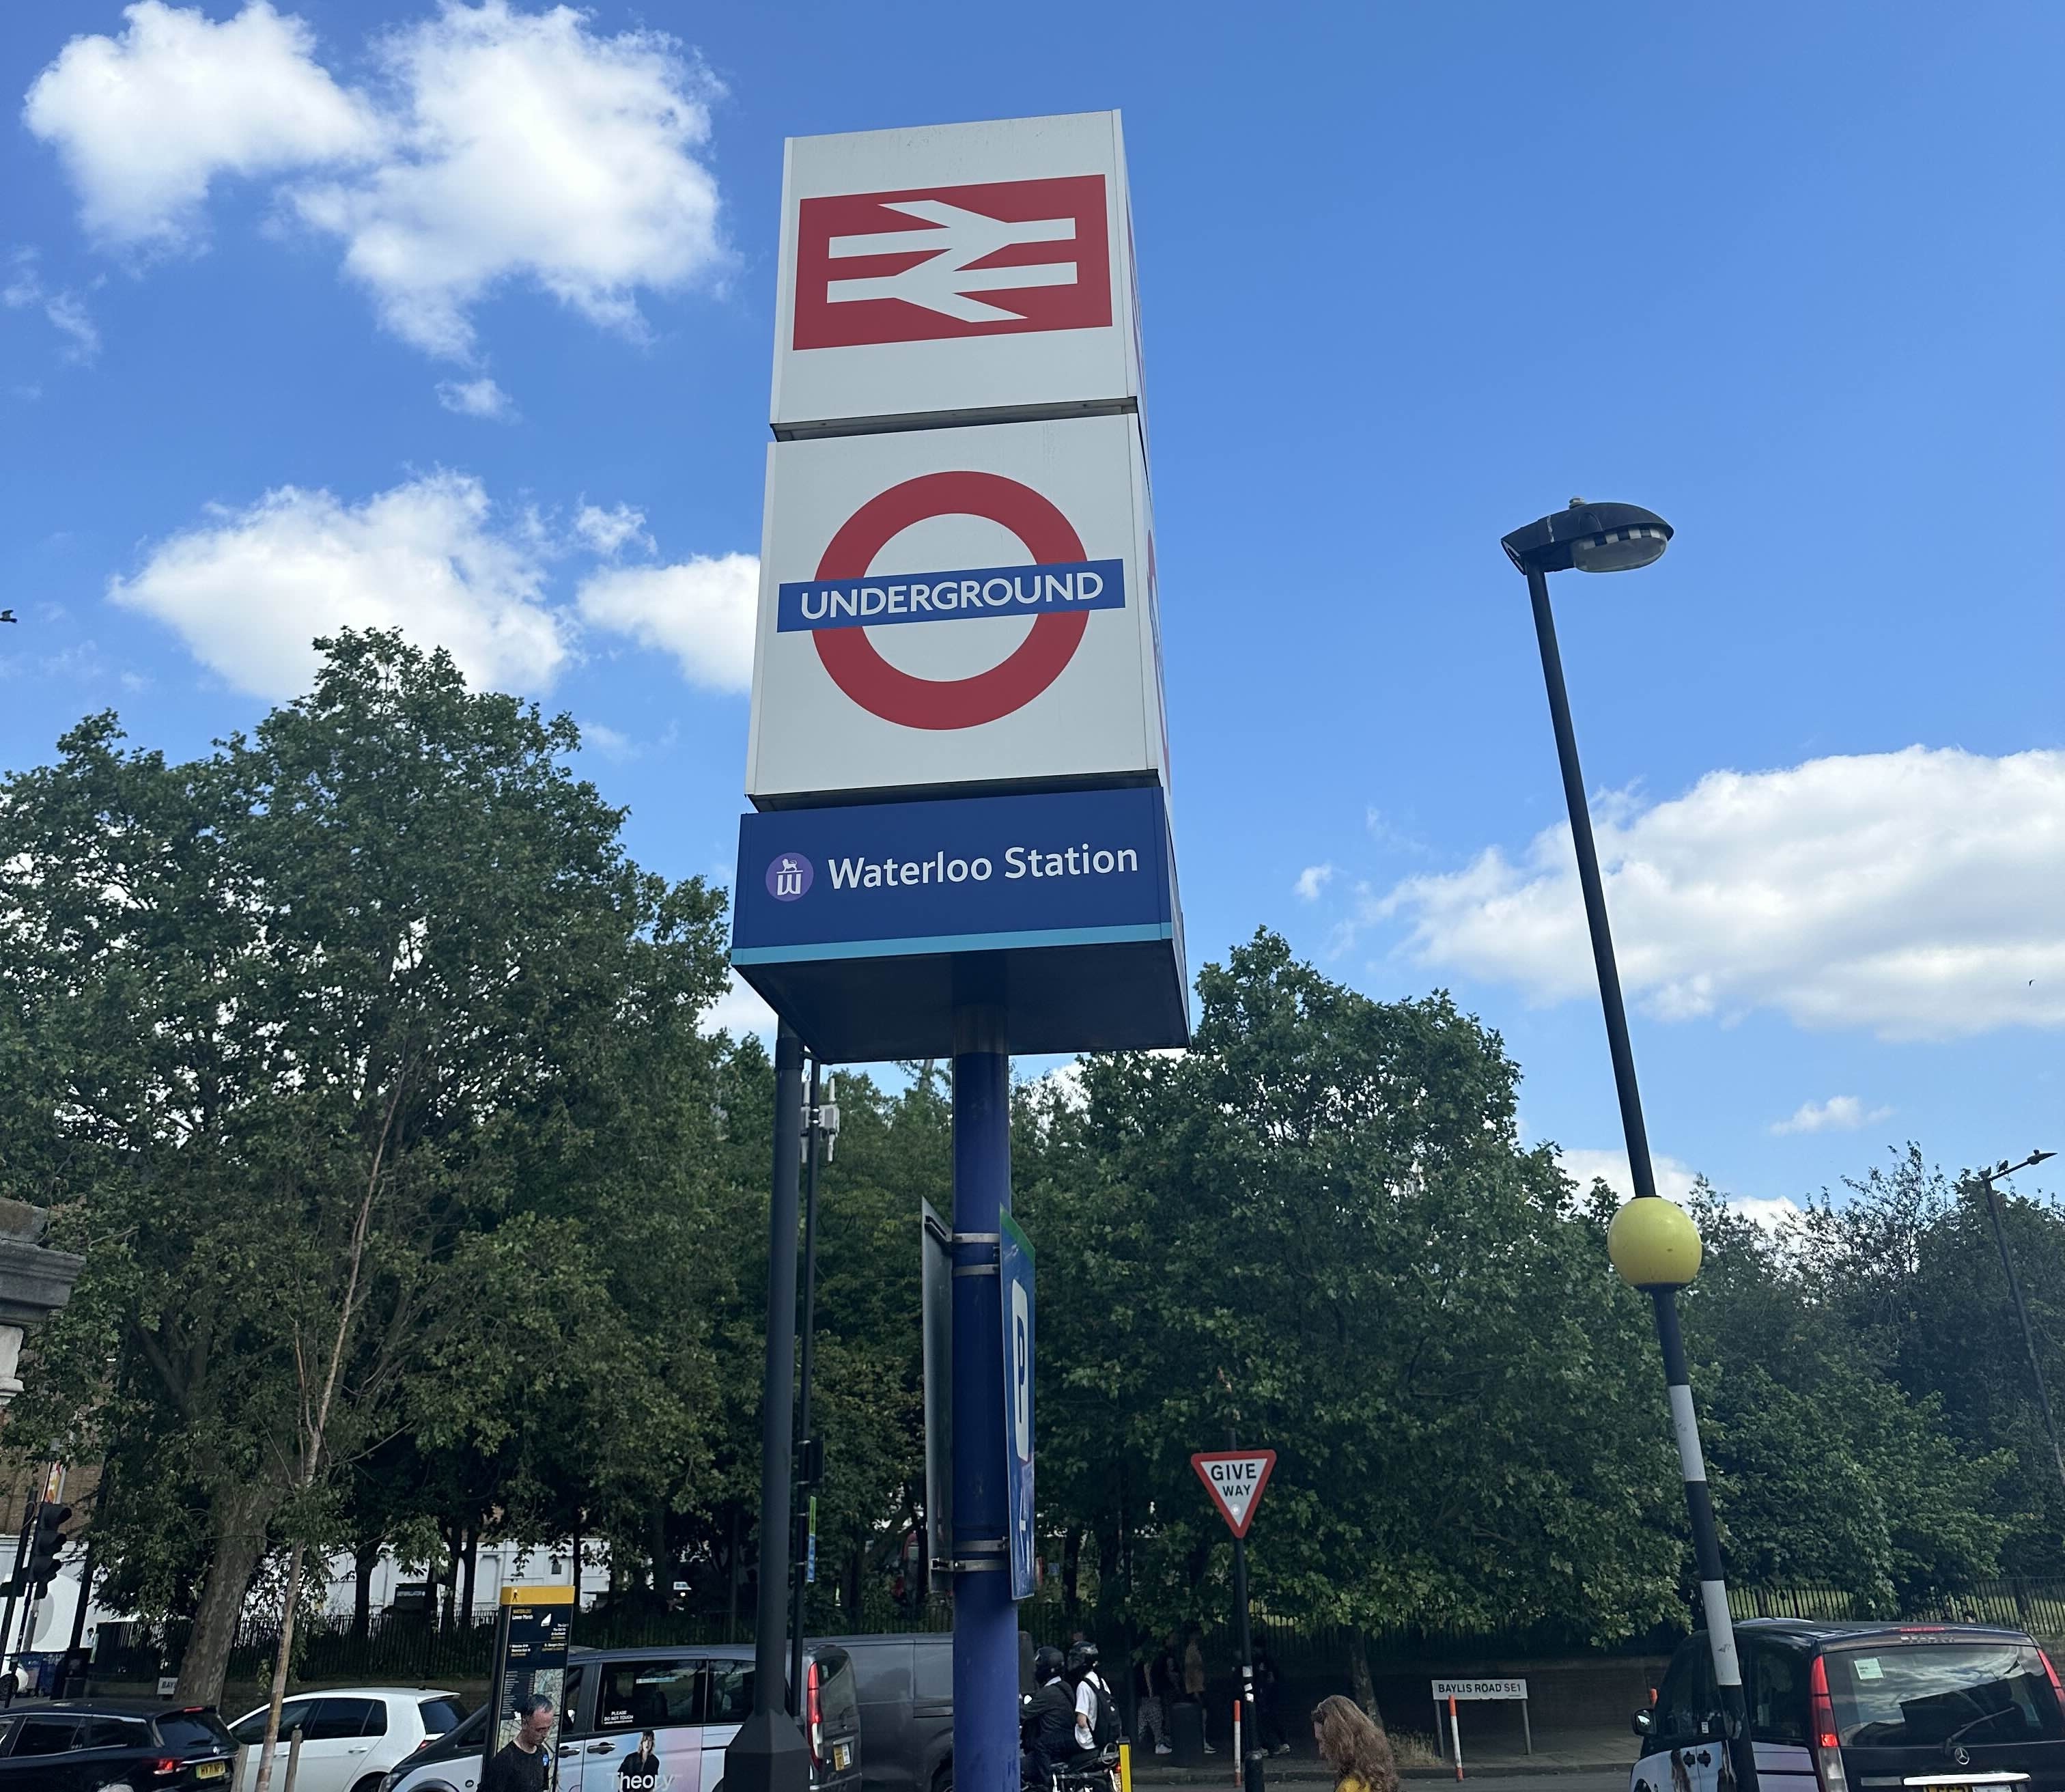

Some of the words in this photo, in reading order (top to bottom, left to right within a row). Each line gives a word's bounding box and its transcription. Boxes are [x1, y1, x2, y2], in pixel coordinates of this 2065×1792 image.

[801, 572, 1104, 620] UNDERGROUND
[828, 851, 992, 889] Waterloo
[1005, 843, 1138, 879] Station
[1211, 1463, 1256, 1481] GIVE
[1222, 1484, 1251, 1496] WAY
[1438, 1683, 1472, 1692] BAYLIS
[1475, 1683, 1502, 1692] ROAD
[1504, 1683, 1521, 1692] SE1
